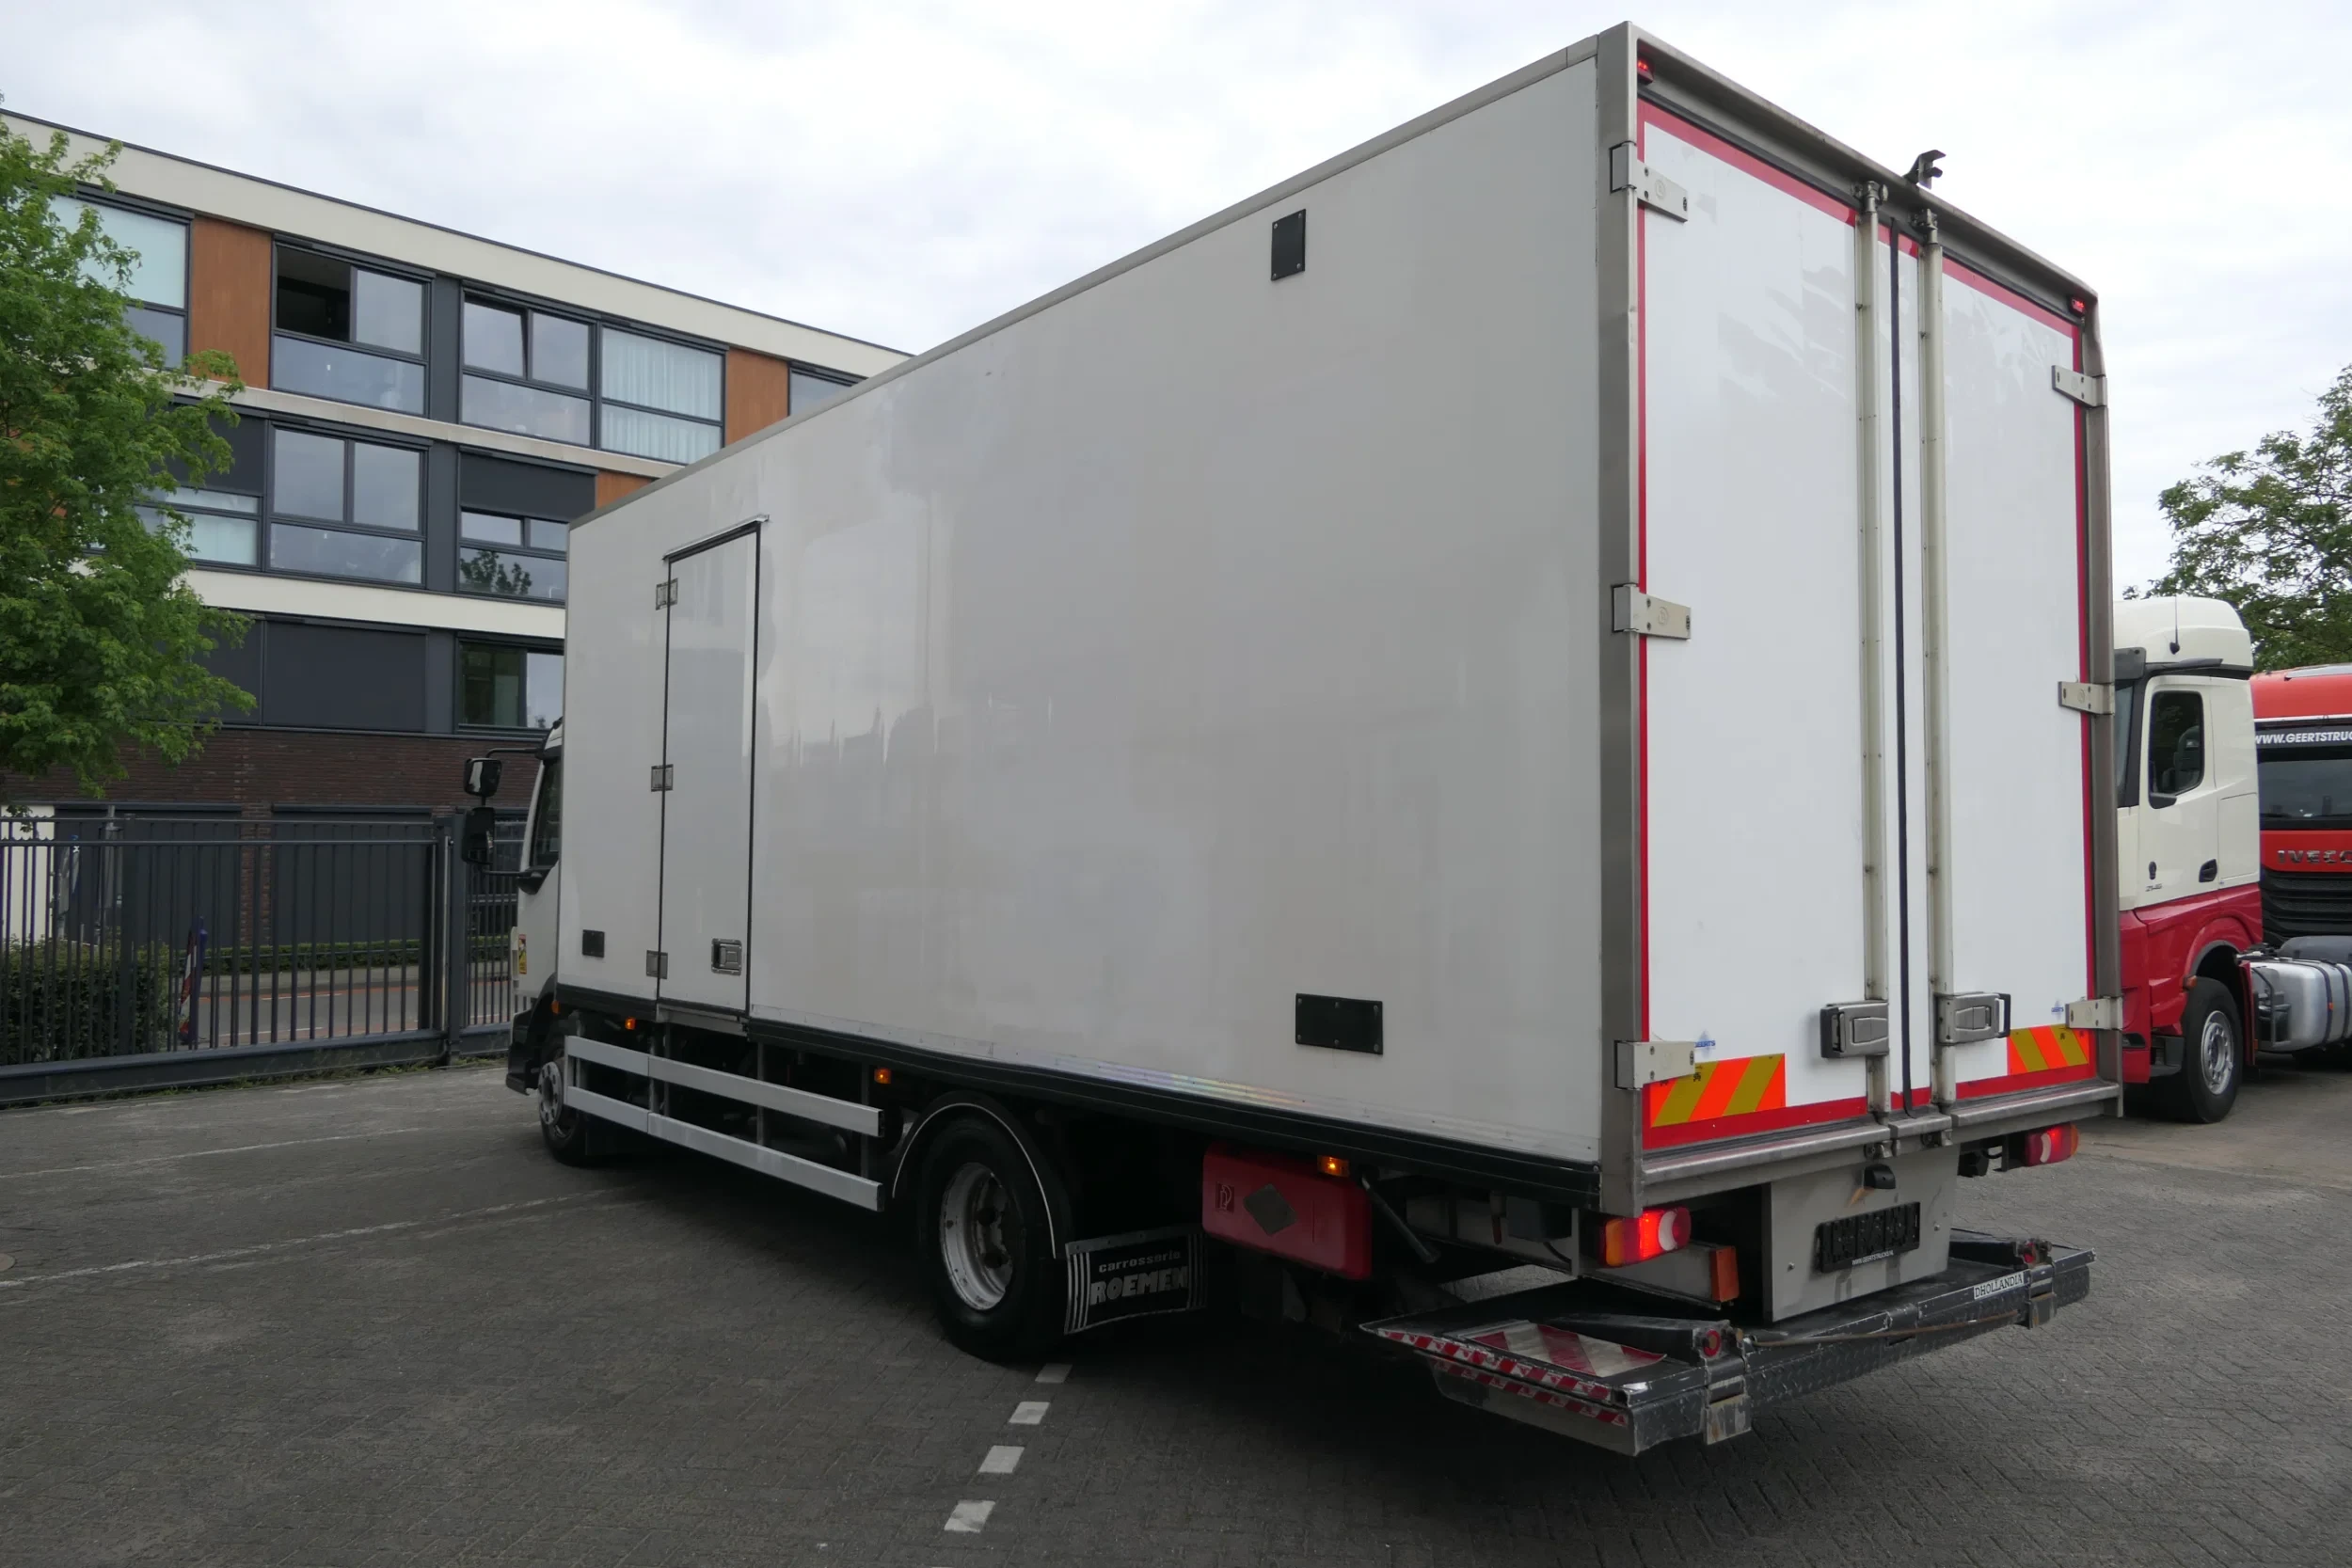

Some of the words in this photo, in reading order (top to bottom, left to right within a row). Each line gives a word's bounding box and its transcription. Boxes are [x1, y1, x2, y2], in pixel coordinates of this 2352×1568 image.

[2278, 850, 2352, 864] IVECO
[1098, 1249, 1182, 1274] carrosserie
[1089, 1265, 1188, 1307] ROEMEN
[1975, 1274, 2023, 1297] DHOLLANDIA
